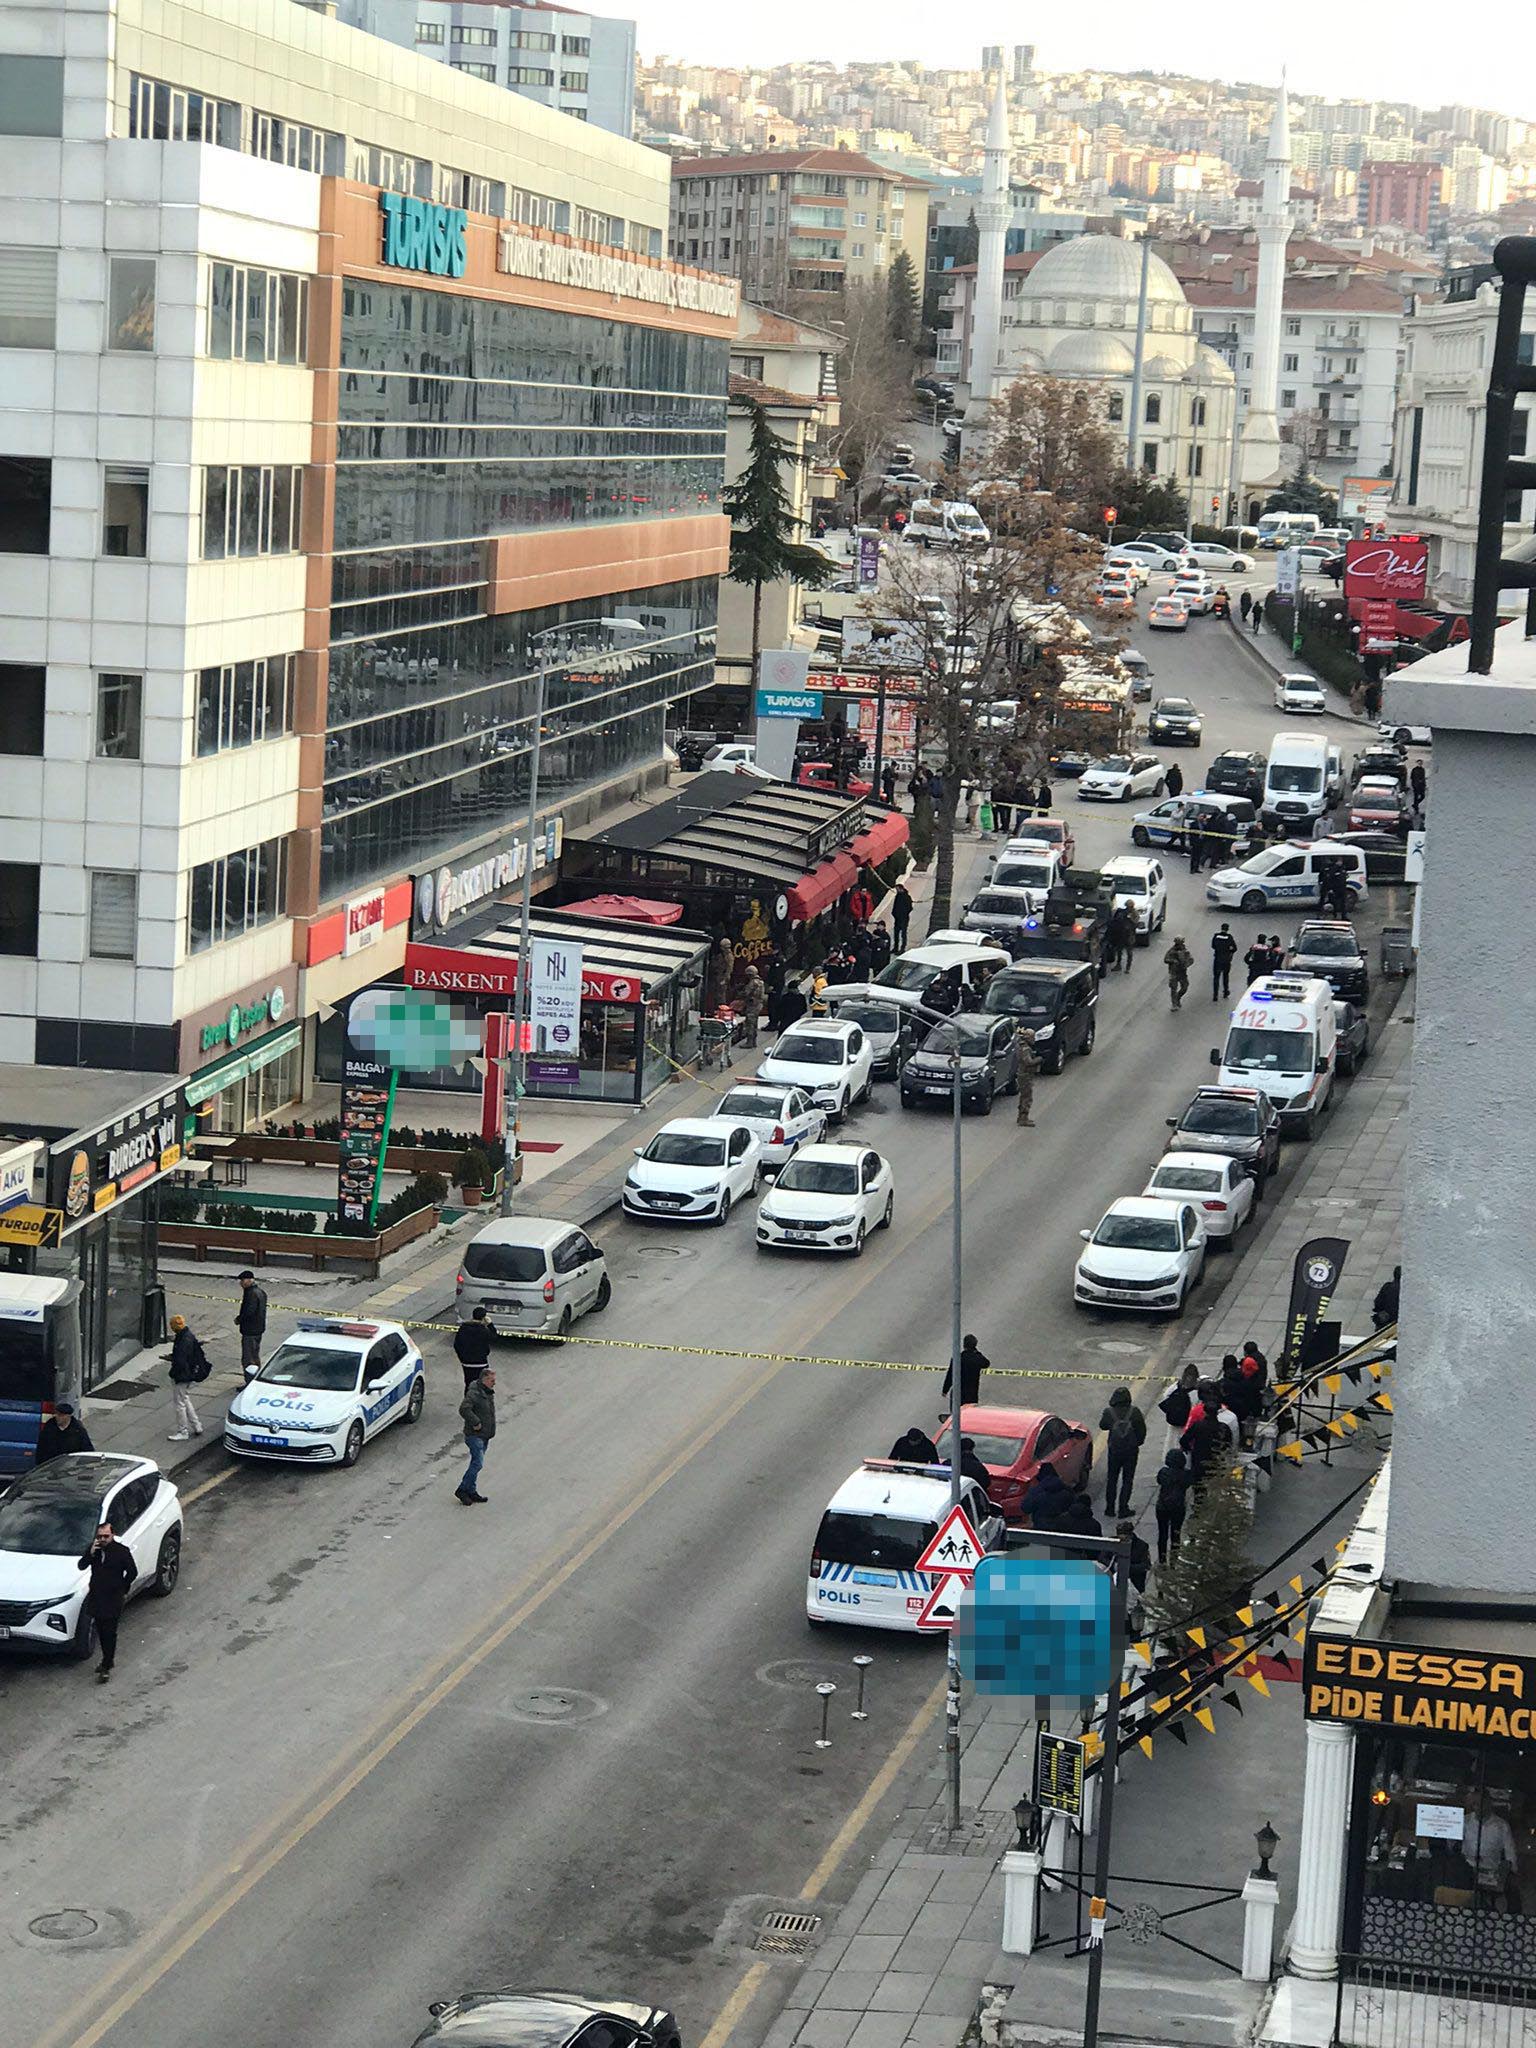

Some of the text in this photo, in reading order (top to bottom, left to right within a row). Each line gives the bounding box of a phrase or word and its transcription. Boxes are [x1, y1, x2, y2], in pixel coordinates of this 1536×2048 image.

[413, 968, 509, 992] BAŞKENT
[537, 996, 560, 1006] %20
[1240, 1009, 1268, 1028] 112
[1313, 1267, 1324, 1278] 72
[256, 1398, 315, 1411] POLIS
[819, 1589, 861, 1605] POLIS
[908, 1598, 922, 1608] 112
[1316, 1642, 1524, 1699] EDESSA
